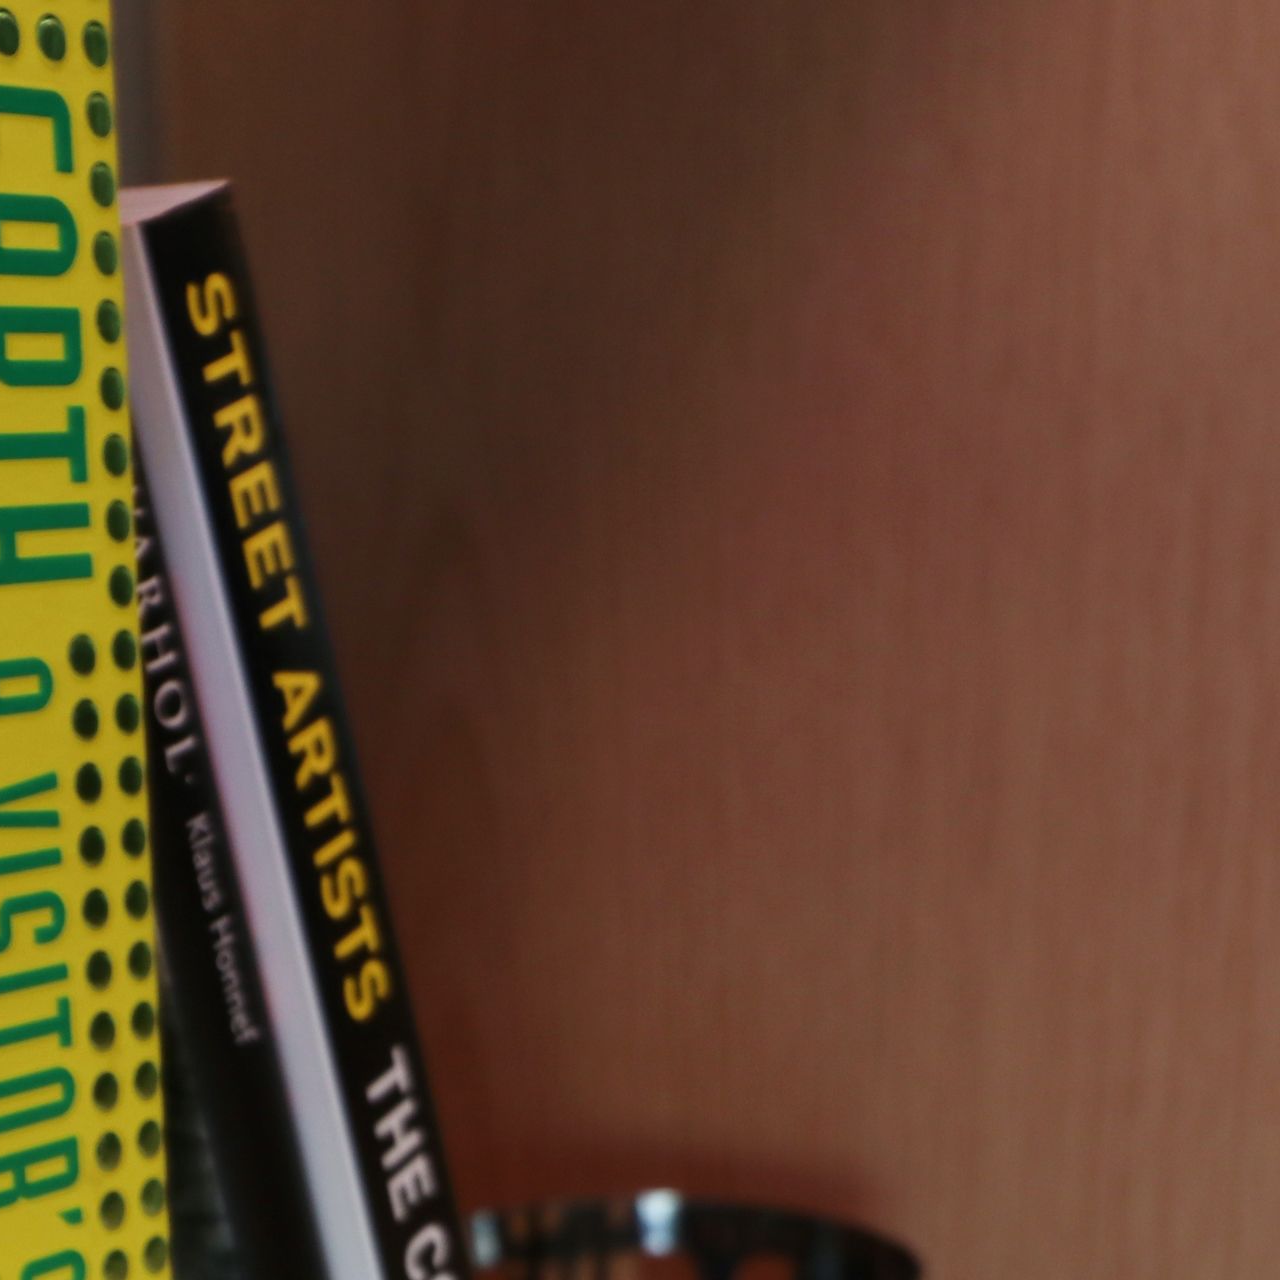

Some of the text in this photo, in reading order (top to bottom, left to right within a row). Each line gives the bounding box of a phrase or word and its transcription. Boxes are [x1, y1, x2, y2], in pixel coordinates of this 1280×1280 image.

[132, 485, 198, 774] ARHOL
[185, 271, 308, 632] STREET
[272, 669, 390, 1023] ARTISTS
[365, 1046, 435, 1222] THE
[186, 810, 222, 913] Klaus
